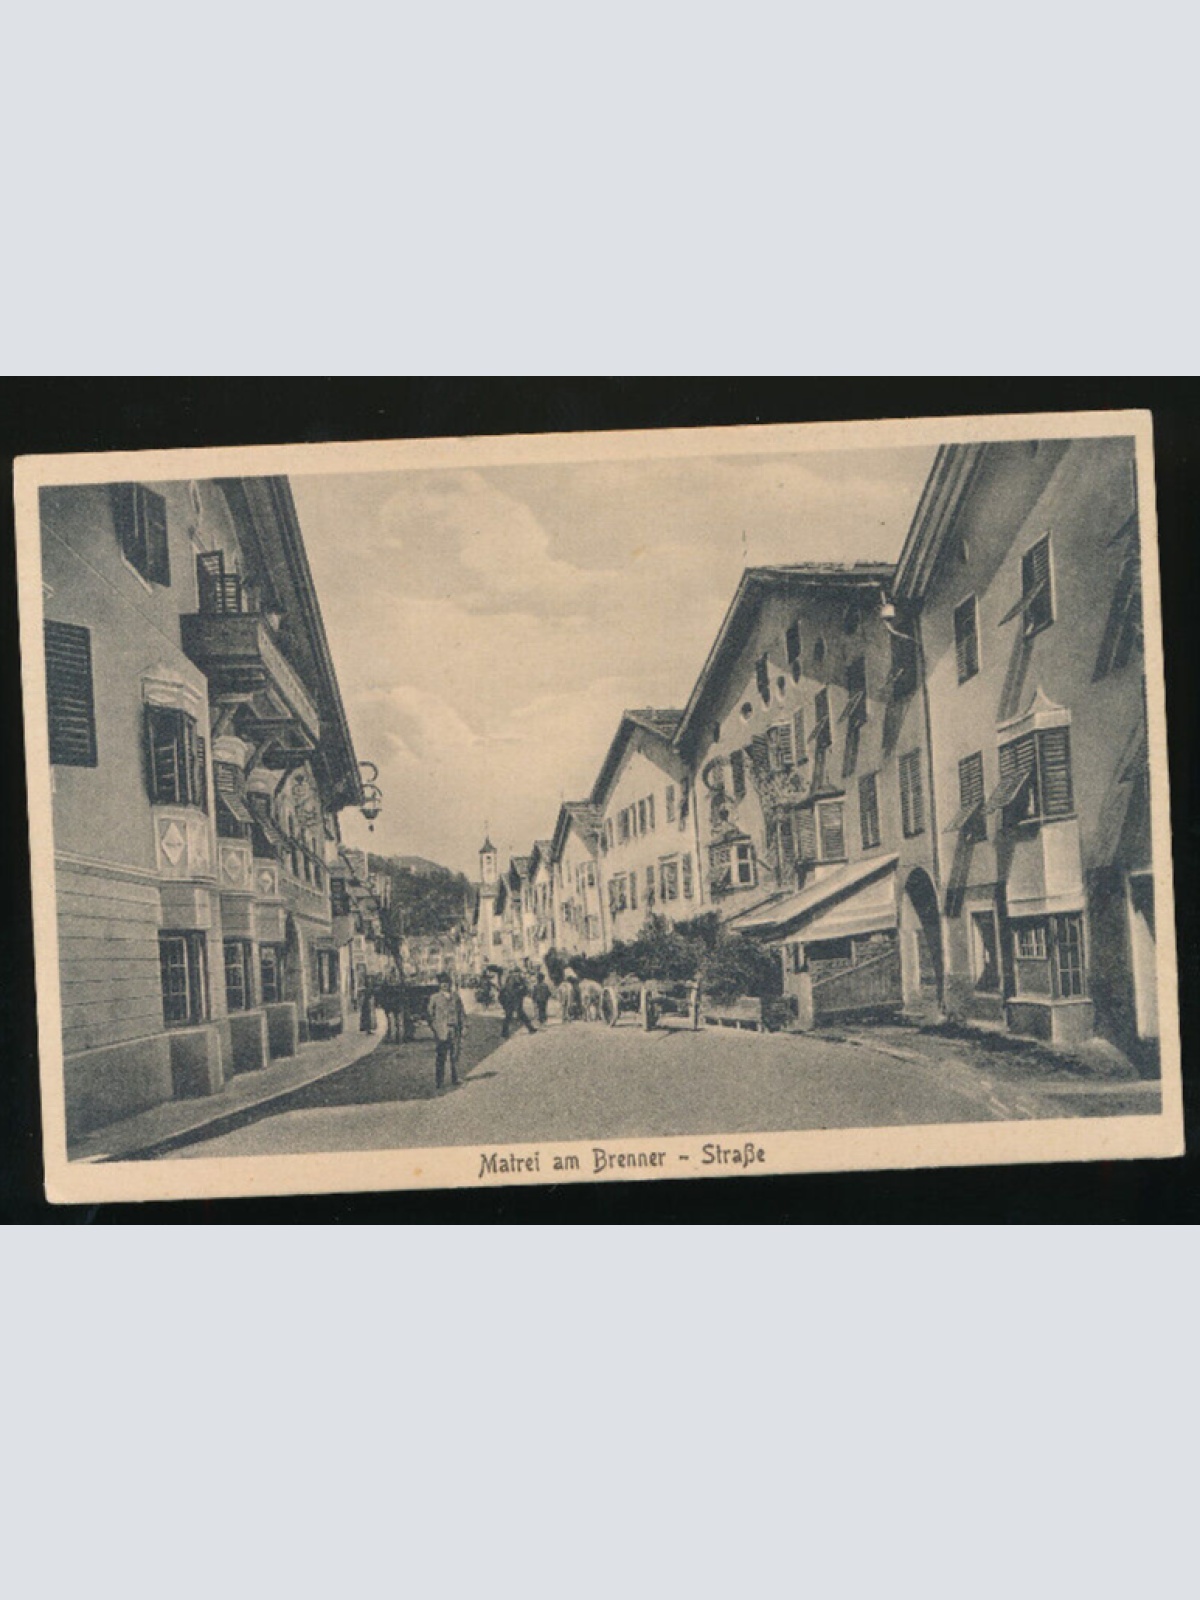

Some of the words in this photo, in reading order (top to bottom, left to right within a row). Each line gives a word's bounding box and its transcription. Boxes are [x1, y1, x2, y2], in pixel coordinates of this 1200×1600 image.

[478, 1151, 540, 1178] Matrei
[553, 1154, 580, 1170] am
[592, 1147, 666, 1174] Brenner
[701, 1142, 766, 1168] Straße
